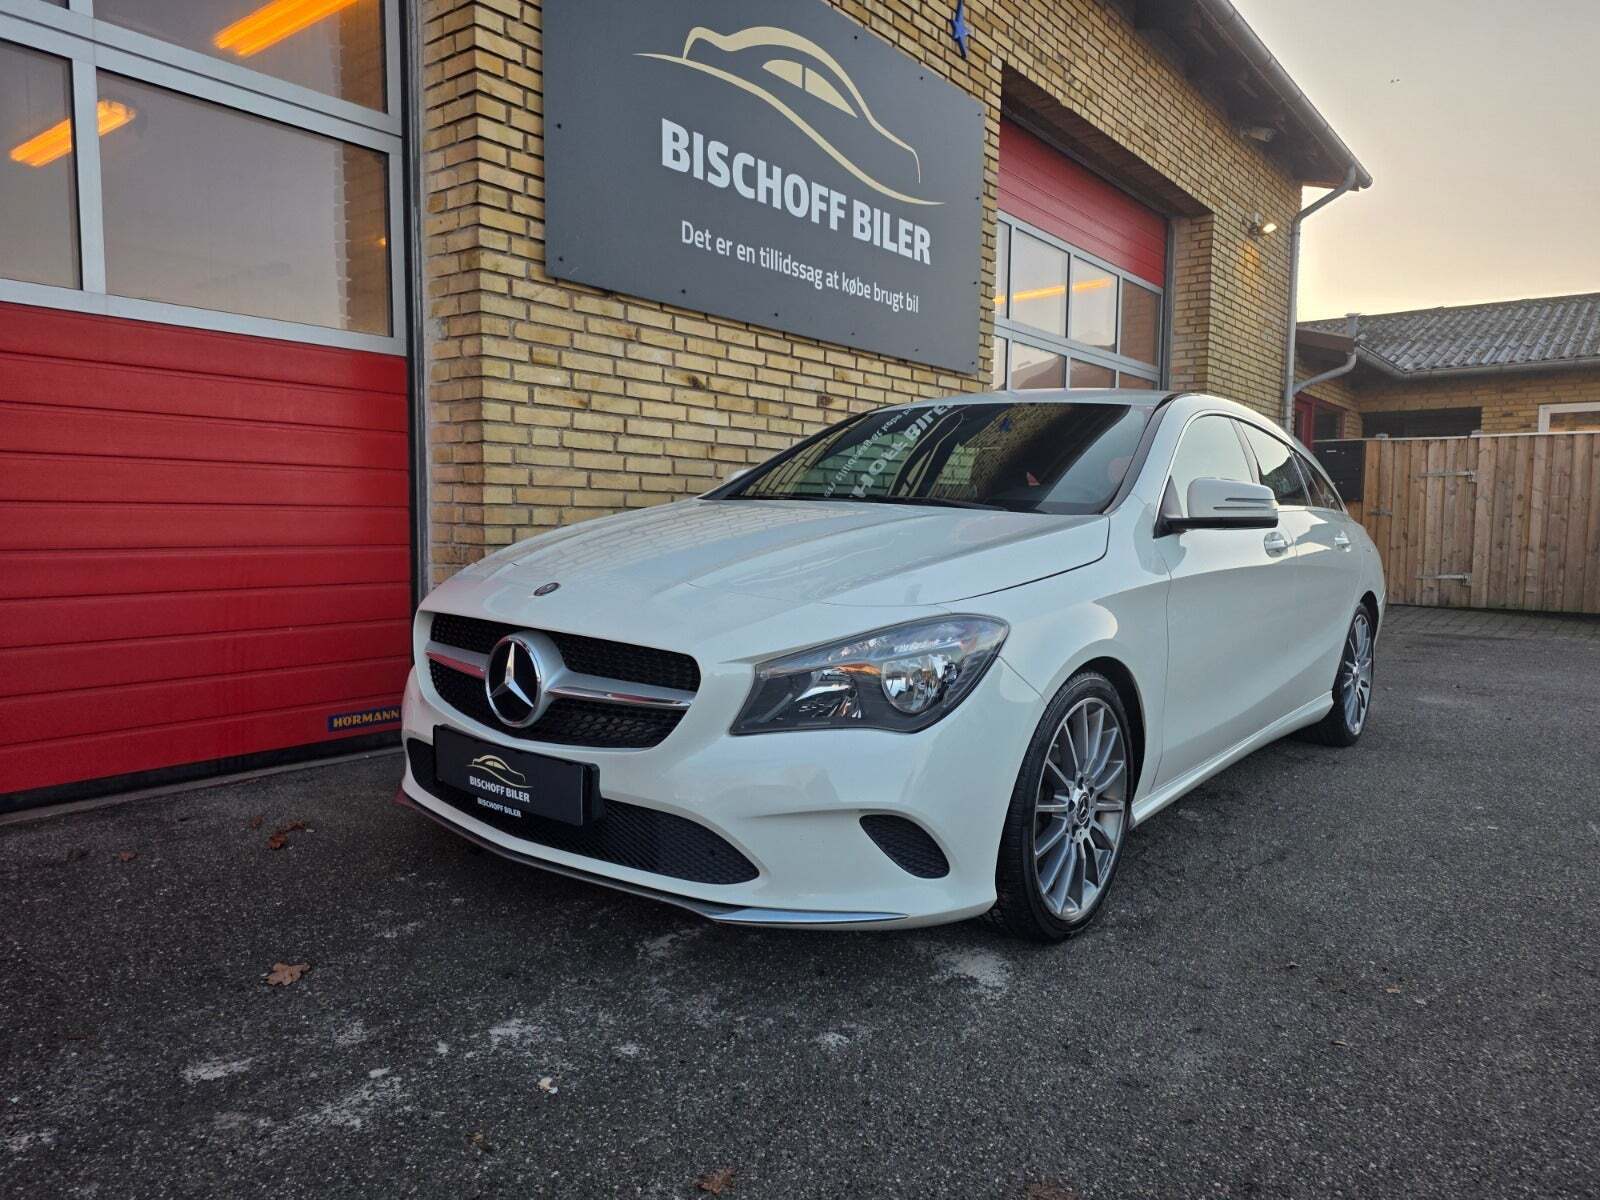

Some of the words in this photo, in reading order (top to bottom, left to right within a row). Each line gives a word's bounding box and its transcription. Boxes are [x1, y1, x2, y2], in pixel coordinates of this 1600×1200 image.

[662, 118, 847, 231] BISCHOFF
[853, 200, 931, 265] BILER
[682, 220, 712, 251] Det
[716, 237, 733, 256] er
[737, 244, 756, 264] en
[760, 247, 823, 290] tillidssag
[826, 271, 840, 290] at
[842, 272, 871, 299] købe
[873, 282, 903, 312] brugt
[906, 293, 919, 313] bil
[469, 775, 505, 796] BISCHOFF
[505, 787, 530, 803] BILER
